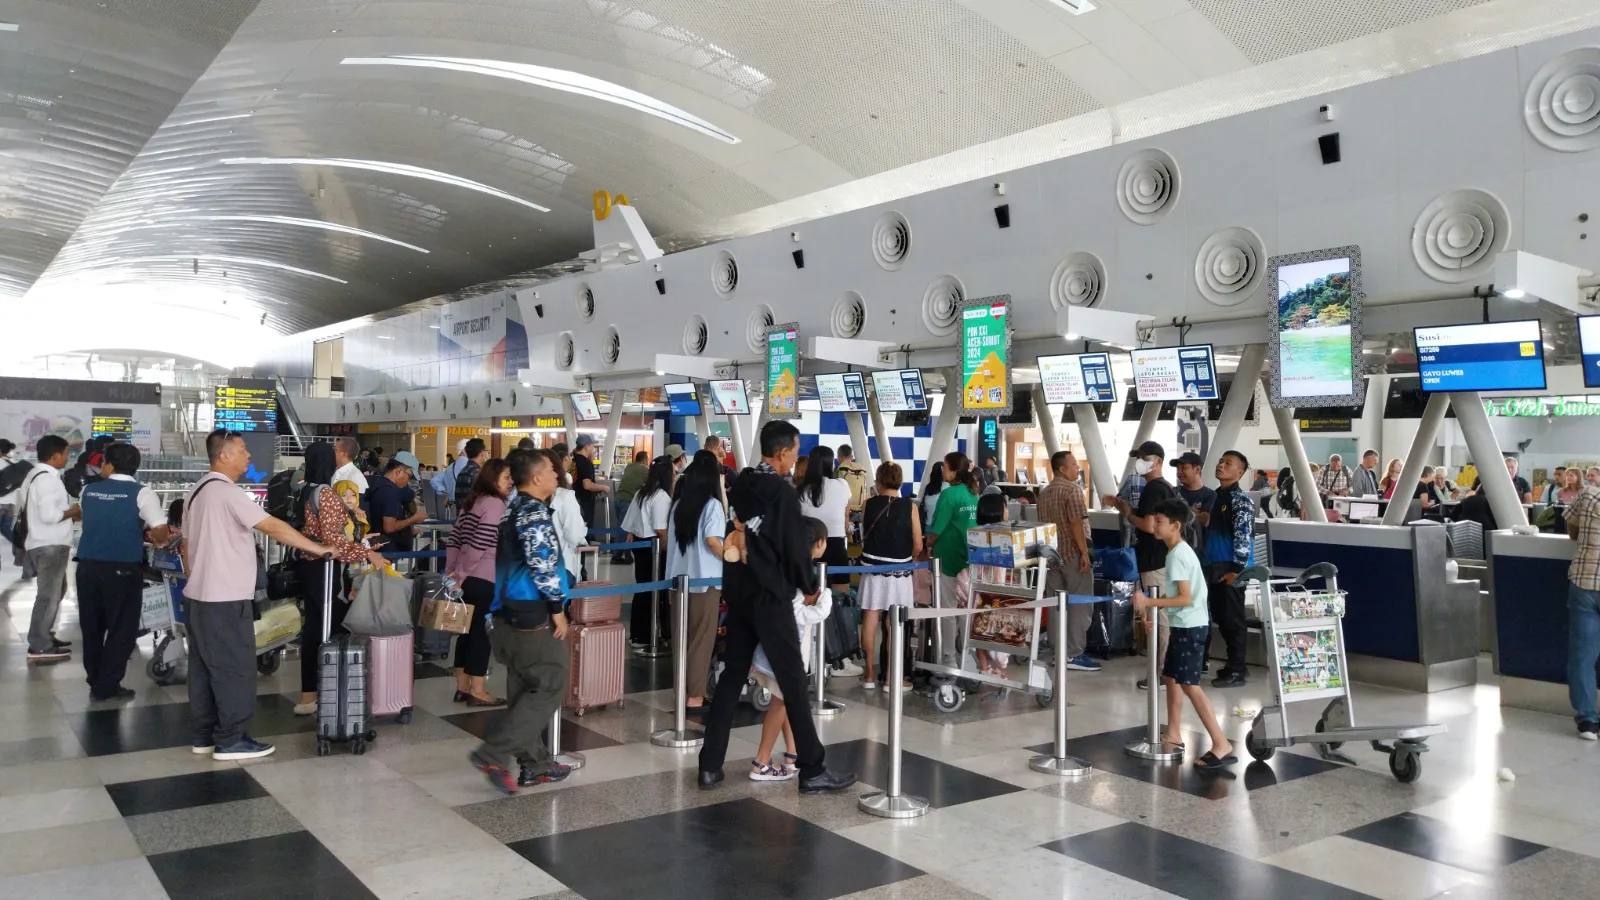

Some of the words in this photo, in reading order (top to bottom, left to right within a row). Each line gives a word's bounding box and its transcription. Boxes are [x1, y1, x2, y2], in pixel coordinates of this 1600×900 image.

[453, 320, 470, 336] AIRPORT
[470, 316, 491, 333] SECURITY
[1418, 333, 1440, 341] Susi
[967, 347, 981, 358] 2024
[502, 418, 518, 428] Medan
